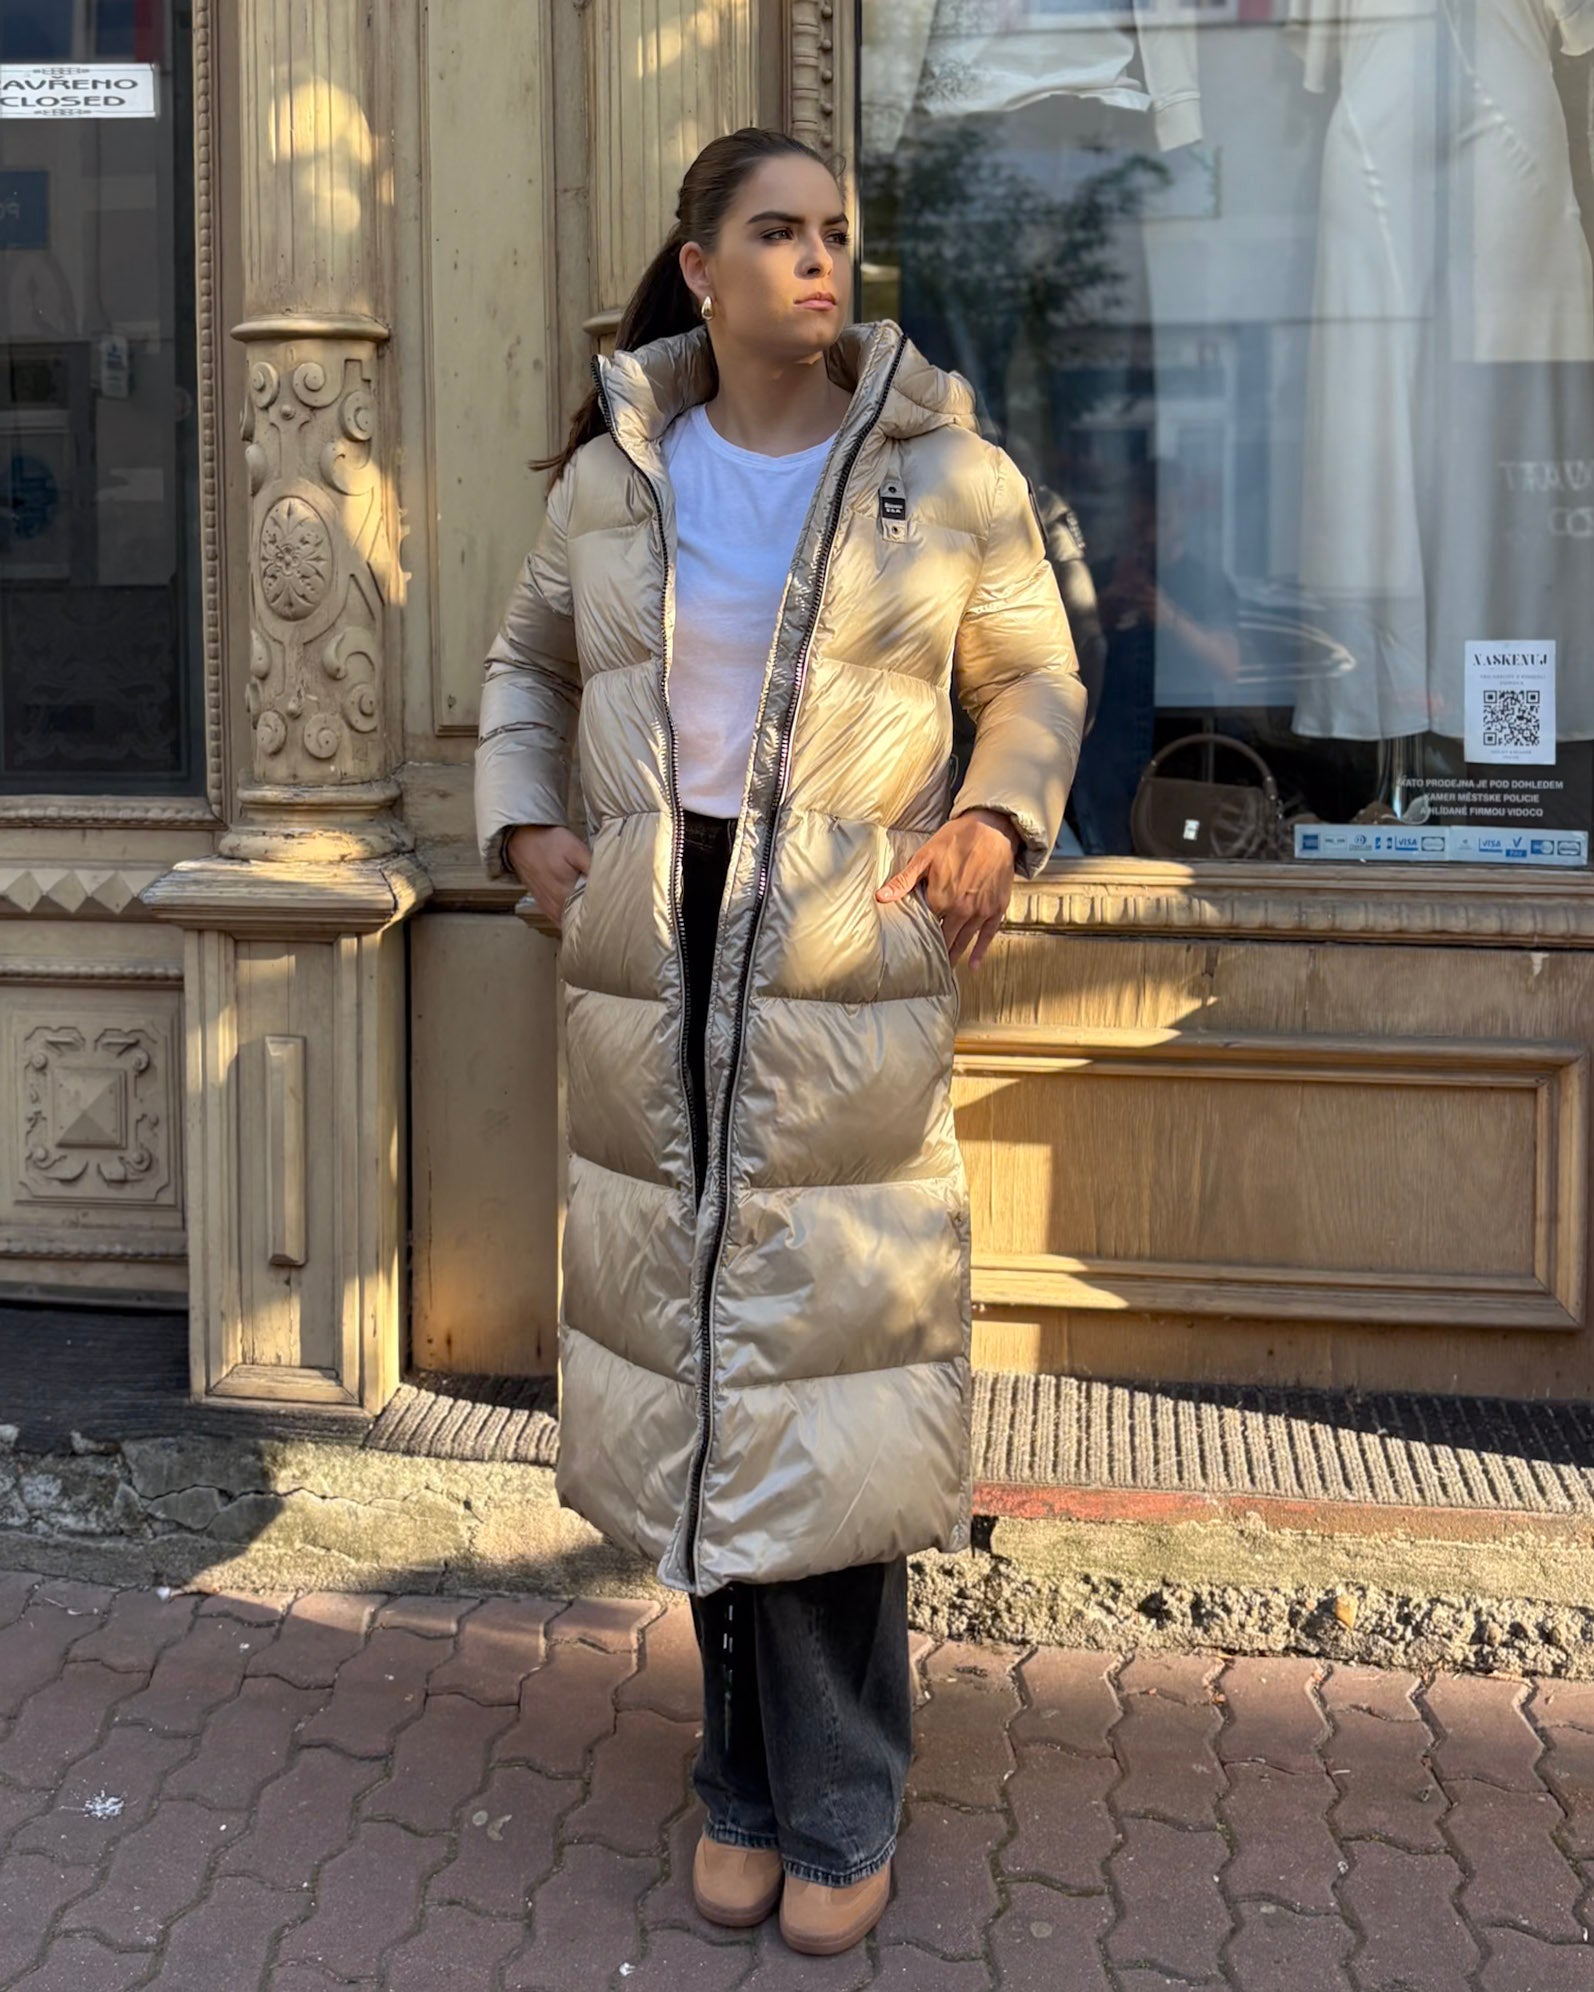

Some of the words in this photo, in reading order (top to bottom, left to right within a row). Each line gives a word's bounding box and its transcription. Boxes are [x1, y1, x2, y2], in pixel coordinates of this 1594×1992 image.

[0, 75, 138, 90] AVŘENO
[0, 96, 126, 107] CLOSED
[1473, 653, 1548, 666] NASKENUJ
[1425, 779, 1475, 788] PRODEJNA
[1476, 779, 1488, 789] JE
[1489, 779, 1510, 789] POD
[1511, 780, 1564, 790] DOHLEDEM
[1469, 806, 1506, 817] FIRMOU
[1399, 838, 1418, 846] VISA
[1482, 839, 1501, 848] VISA
